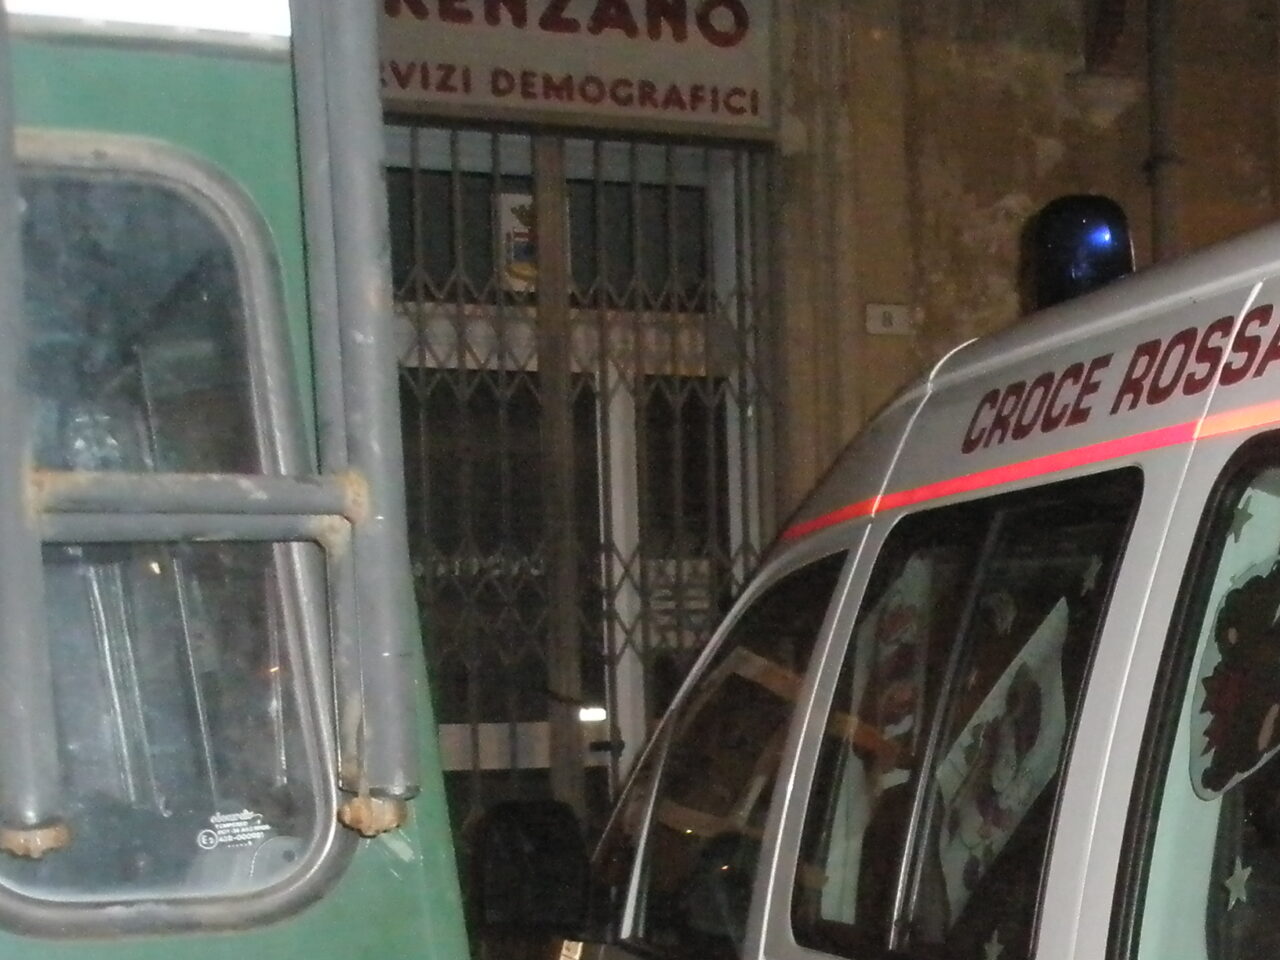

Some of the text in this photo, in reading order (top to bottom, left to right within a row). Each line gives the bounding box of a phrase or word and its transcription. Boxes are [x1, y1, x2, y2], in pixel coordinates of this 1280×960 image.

[379, 60, 760, 117] VIZI DEMOGRAFICI
[961, 352, 1114, 455] CROCE
